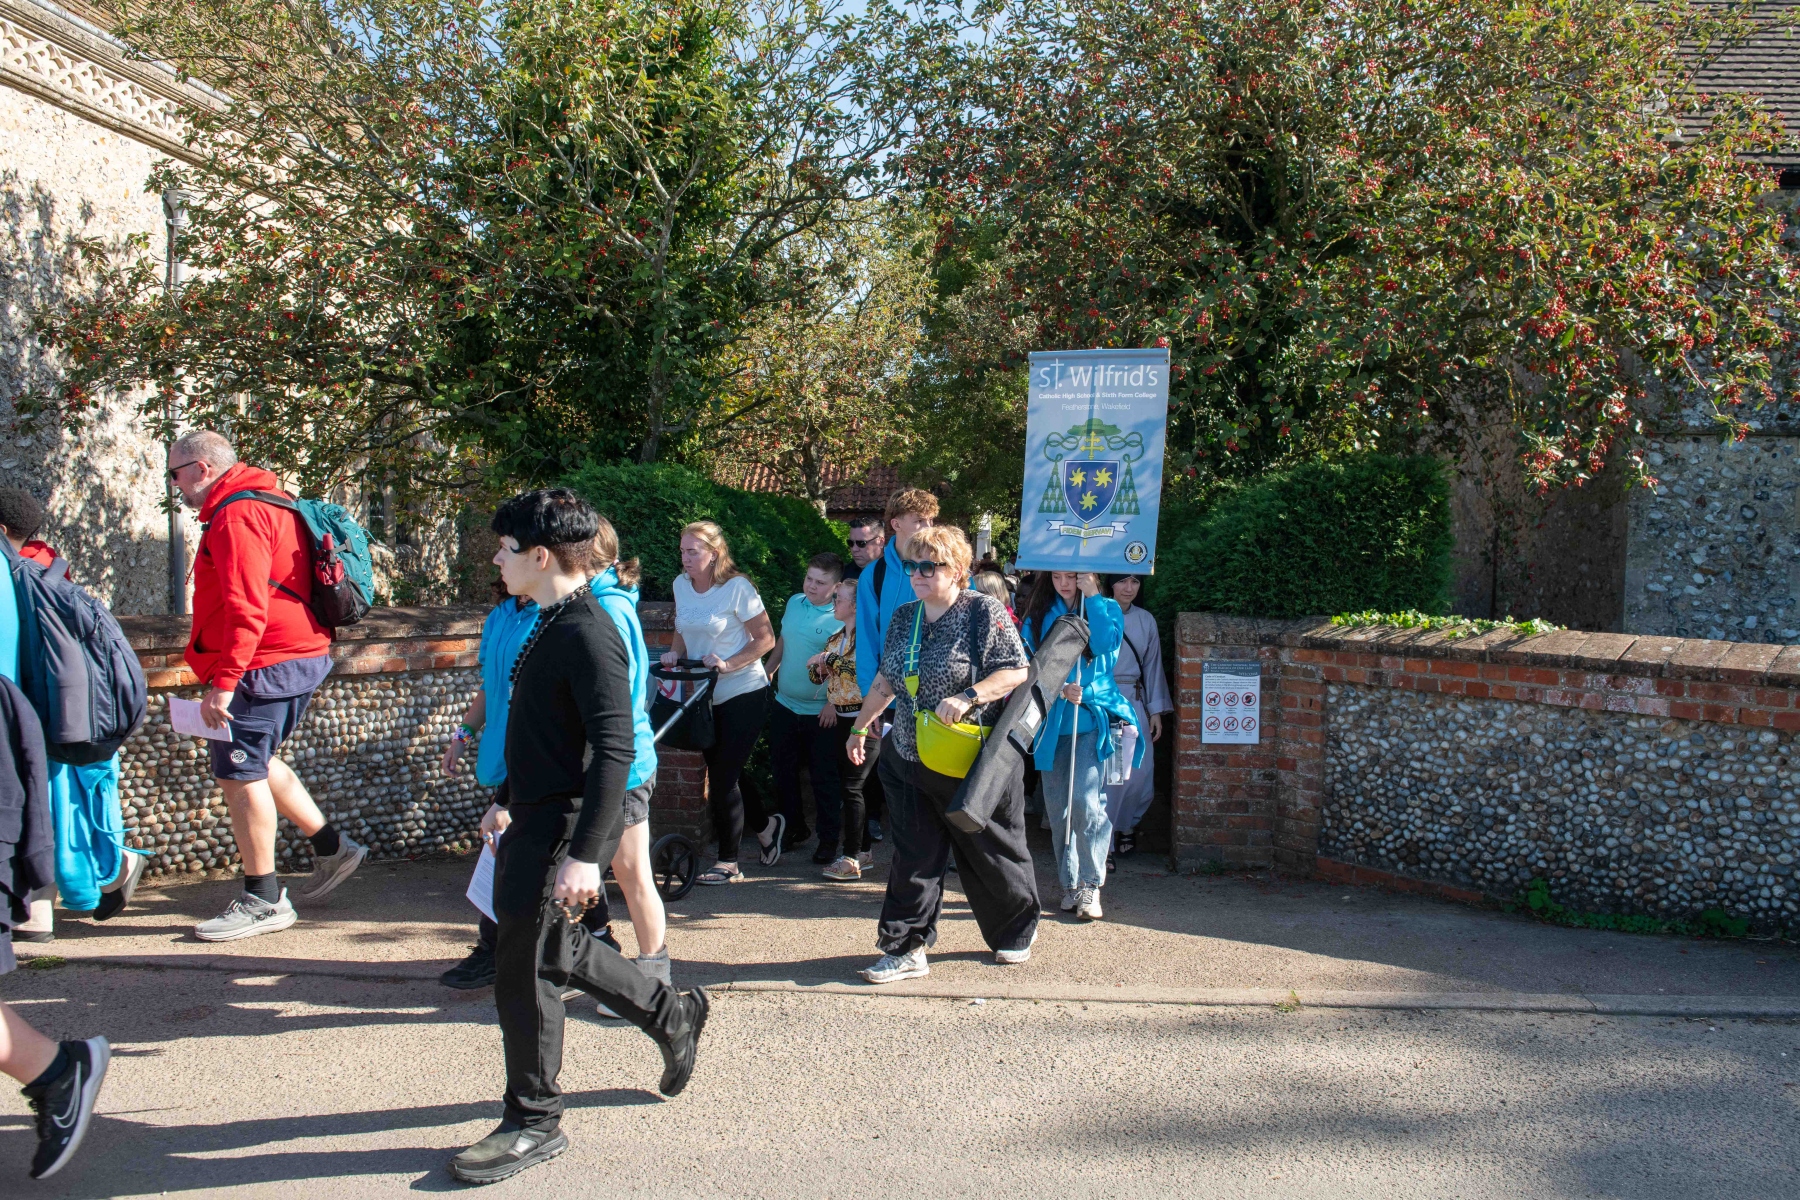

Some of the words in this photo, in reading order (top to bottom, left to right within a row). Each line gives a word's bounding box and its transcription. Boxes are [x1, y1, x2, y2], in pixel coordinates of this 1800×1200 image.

[1039, 358, 1064, 389] St.
[1070, 365, 1158, 387] Wilfrid's
[1062, 527, 1082, 535] FIDEM
[251, 908, 277, 924] HOKA
